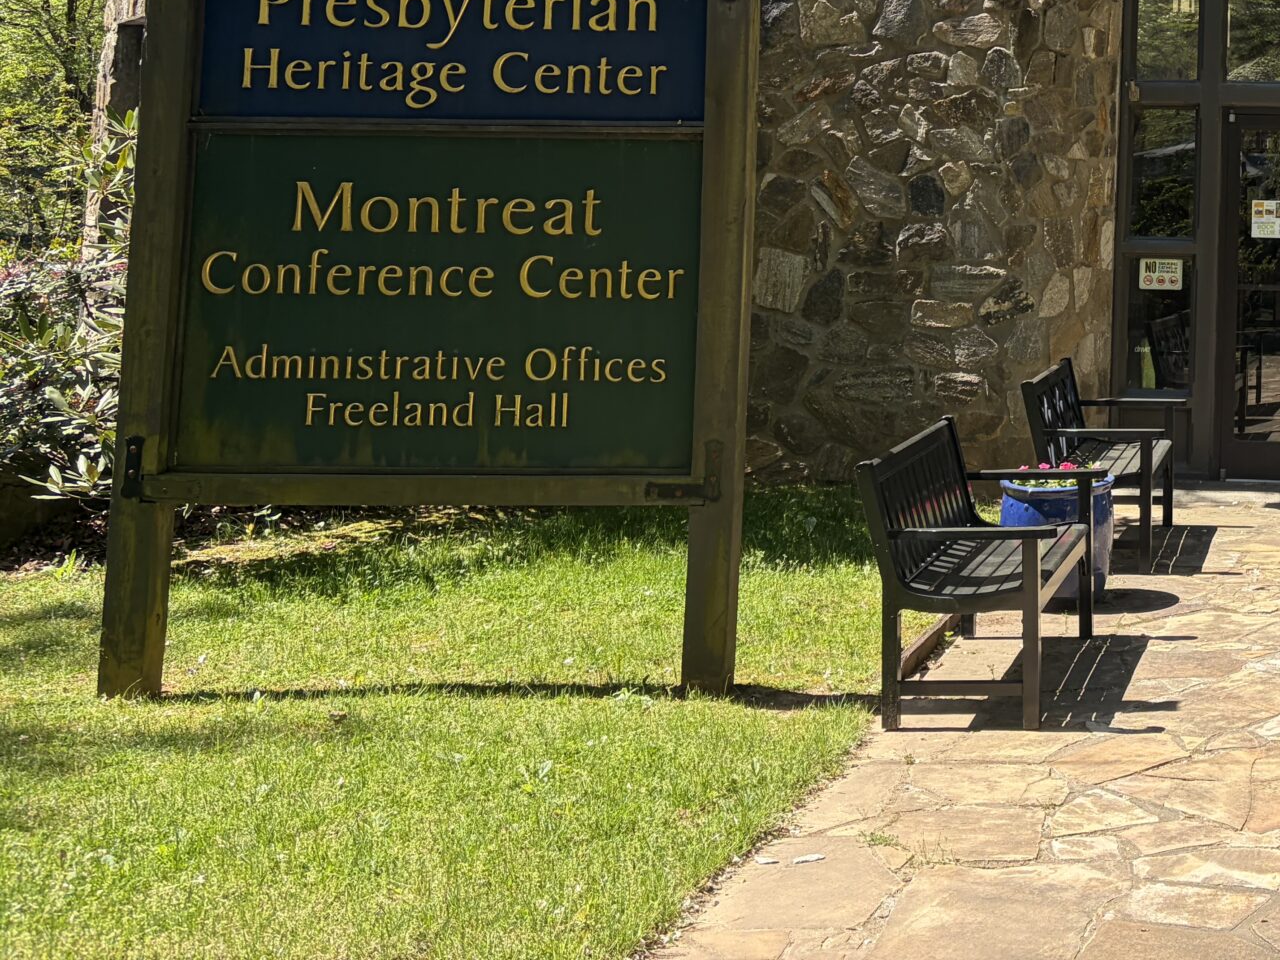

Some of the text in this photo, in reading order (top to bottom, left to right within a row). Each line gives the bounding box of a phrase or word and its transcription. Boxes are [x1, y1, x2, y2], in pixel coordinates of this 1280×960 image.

[240, 47, 667, 108] Heritage Center
[291, 181, 602, 236] Montreat
[201, 249, 684, 300] Conference Center
[1145, 261, 1157, 274] NO
[210, 344, 667, 383] Administrative Offices
[304, 392, 569, 428] Freeland Hall
